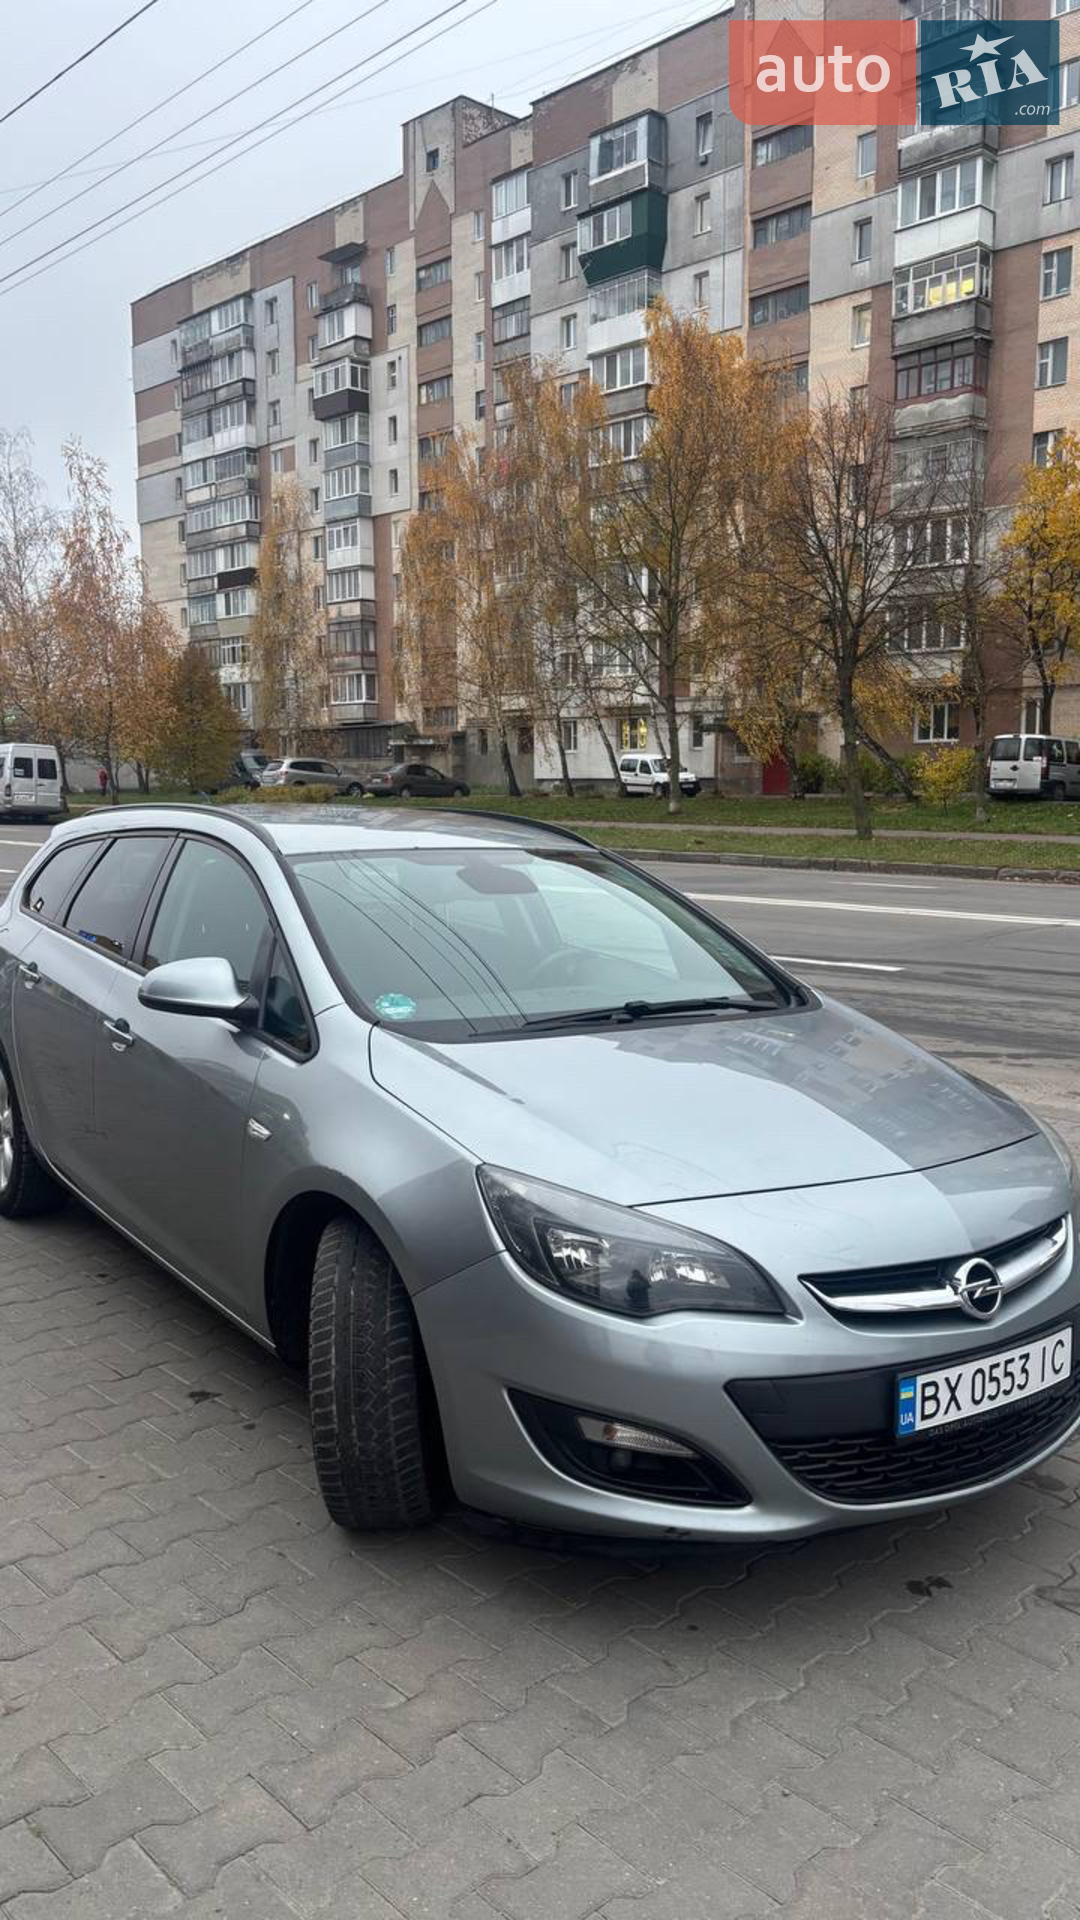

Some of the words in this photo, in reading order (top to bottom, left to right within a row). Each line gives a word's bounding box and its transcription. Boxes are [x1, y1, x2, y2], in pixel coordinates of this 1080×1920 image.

[920, 1373, 962, 1421] BX
[971, 1352, 1030, 1405] 0553
[900, 1412, 914, 1426] UA
